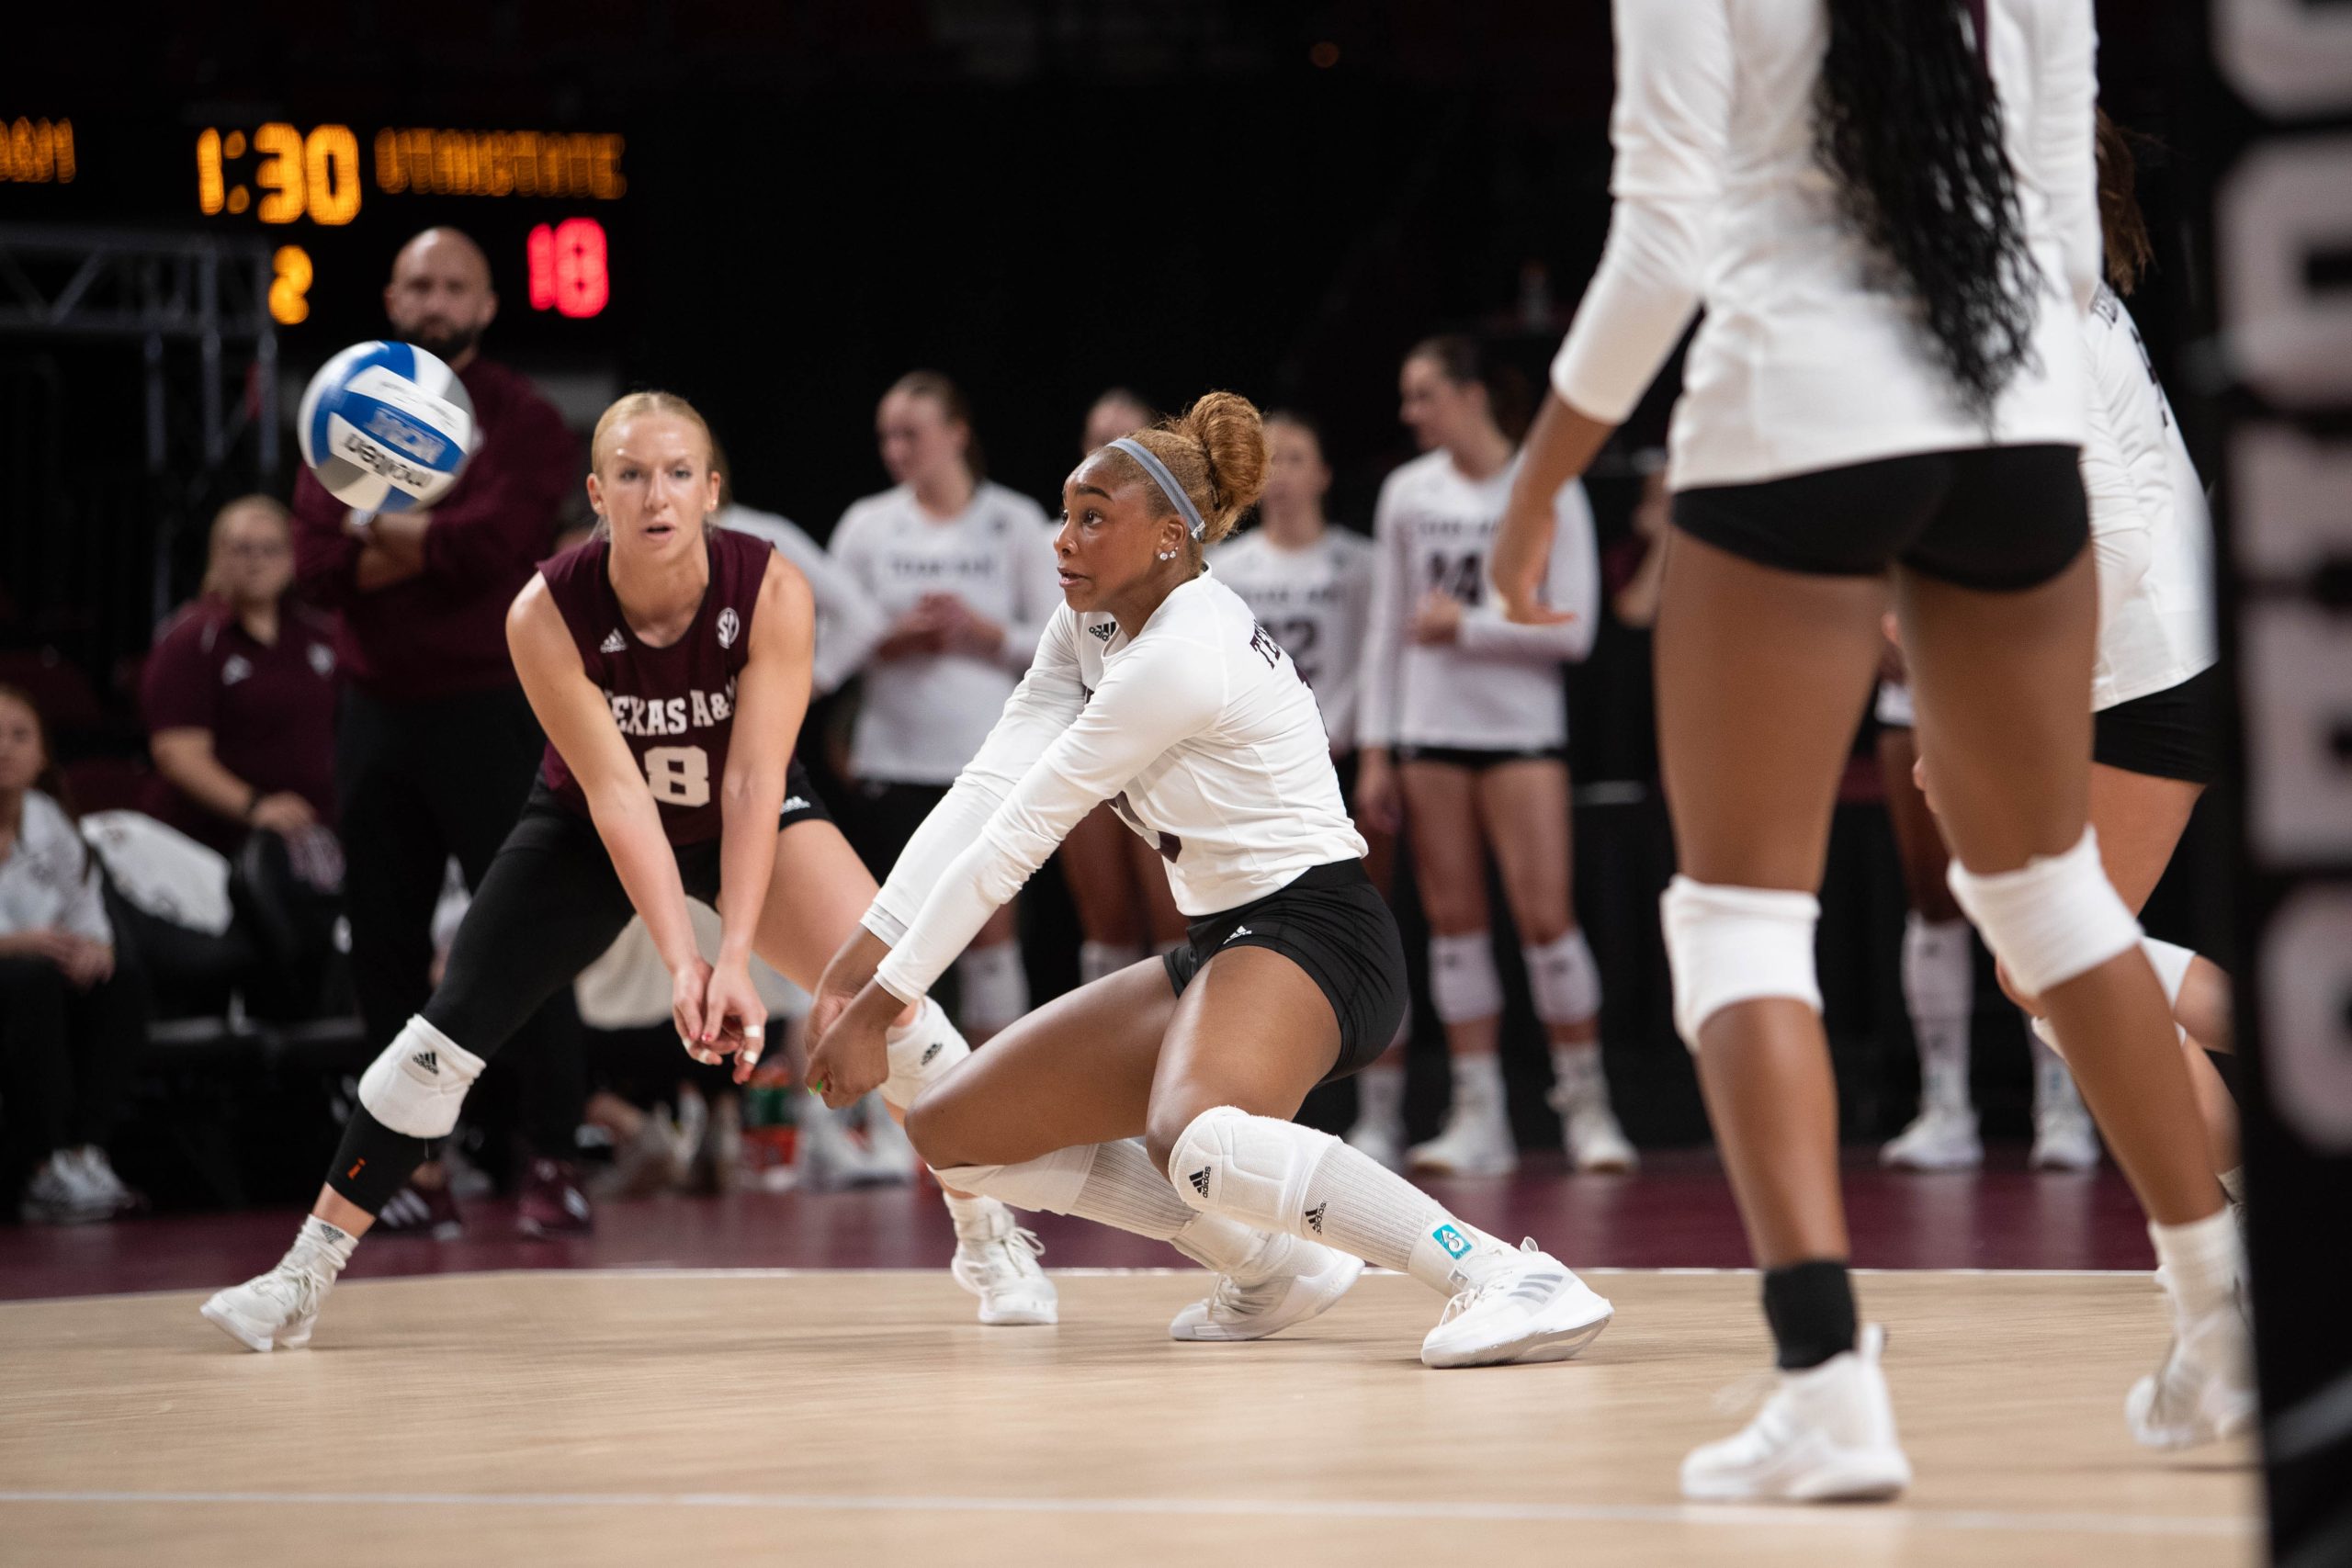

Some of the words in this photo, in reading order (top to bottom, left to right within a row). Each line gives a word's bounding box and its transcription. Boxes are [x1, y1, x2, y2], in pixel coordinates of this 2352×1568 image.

[197, 123, 362, 225] 1:30
[1088, 626, 1110, 642] adid
[604, 689, 687, 736] EXAS
[644, 746, 710, 807] 8
[1203, 1166, 1211, 1198] adidas
